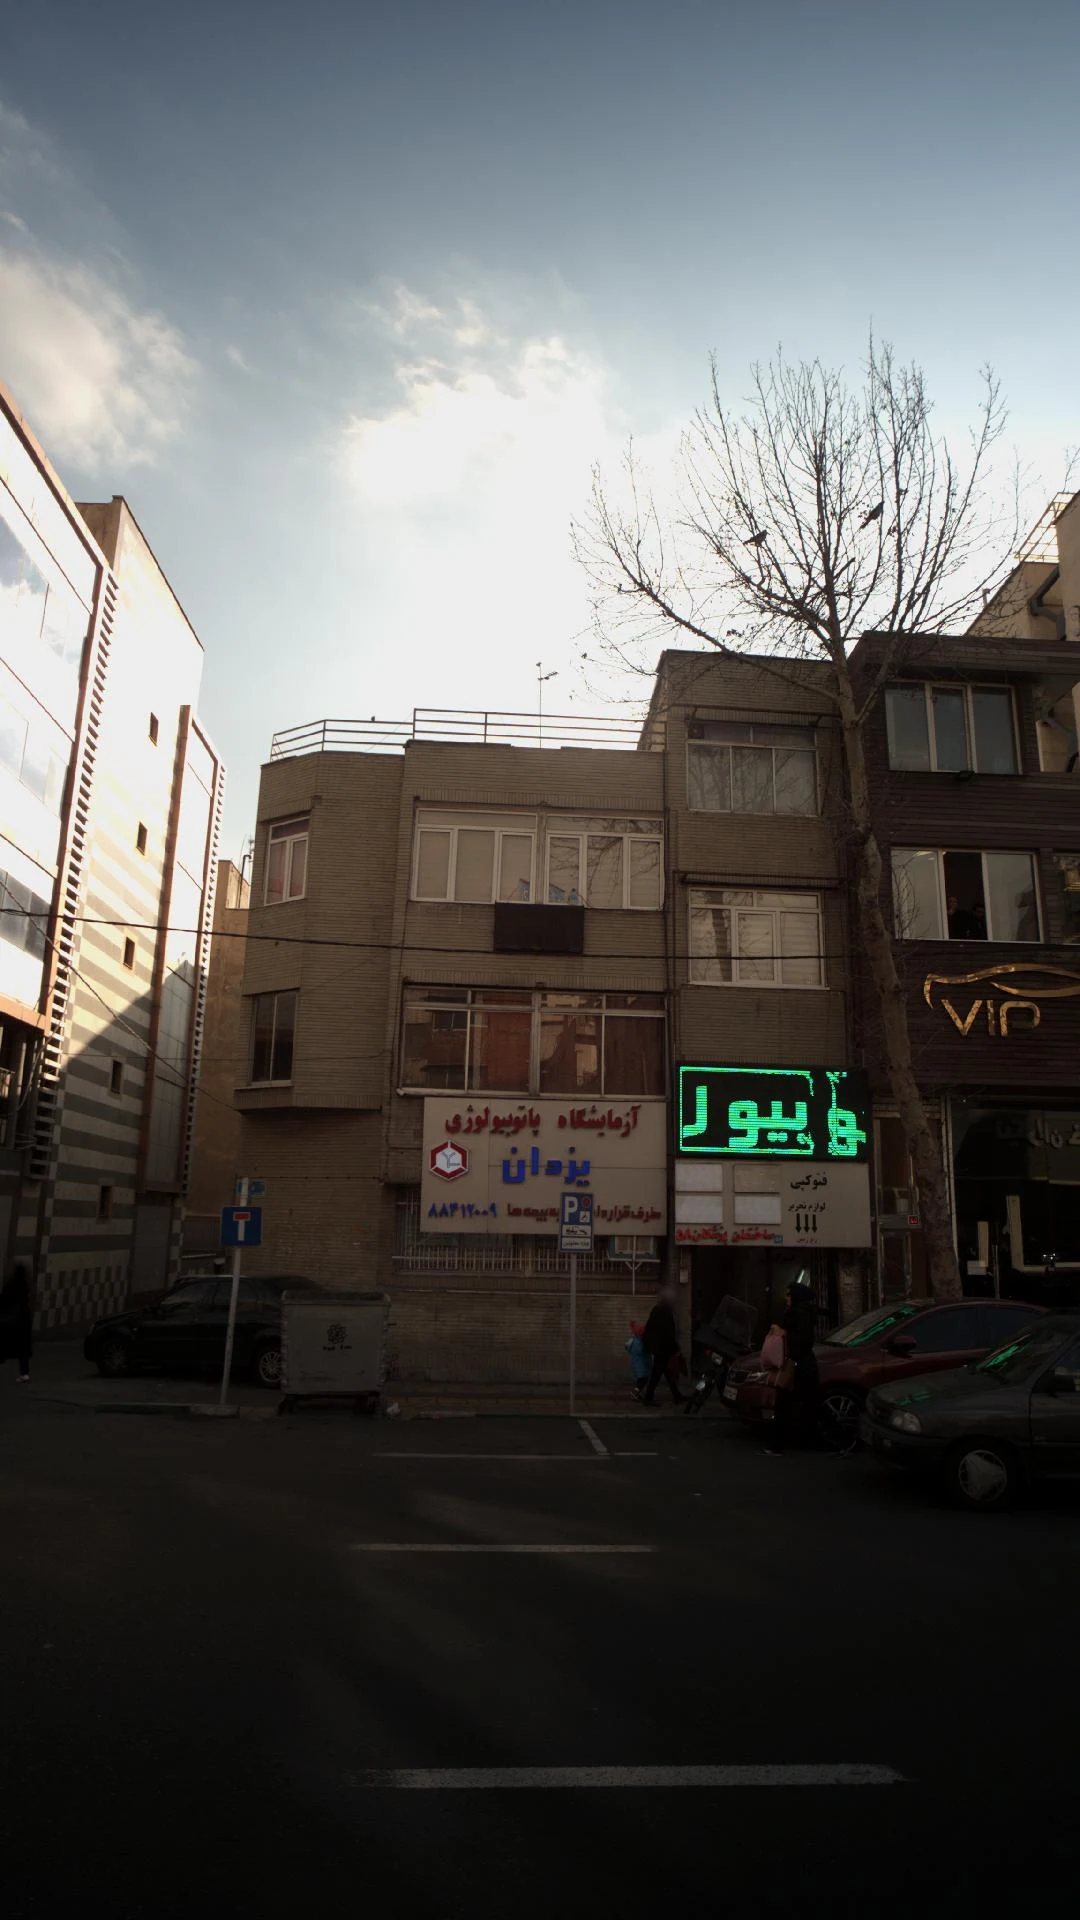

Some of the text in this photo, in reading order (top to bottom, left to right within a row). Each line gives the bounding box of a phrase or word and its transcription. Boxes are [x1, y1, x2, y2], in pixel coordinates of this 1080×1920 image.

[940, 999, 1041, 1038] VIP
[445, 1104, 642, 1138] آزمایشگاه پاتوبیولوژی
[502, 1146, 591, 1187] یزدان
[790, 1171, 828, 1191] فتوکپی
[564, 1196, 578, 1223] P
[593, 1205, 630, 1222] قراردا
[630, 1206, 662, 1223] طرف
